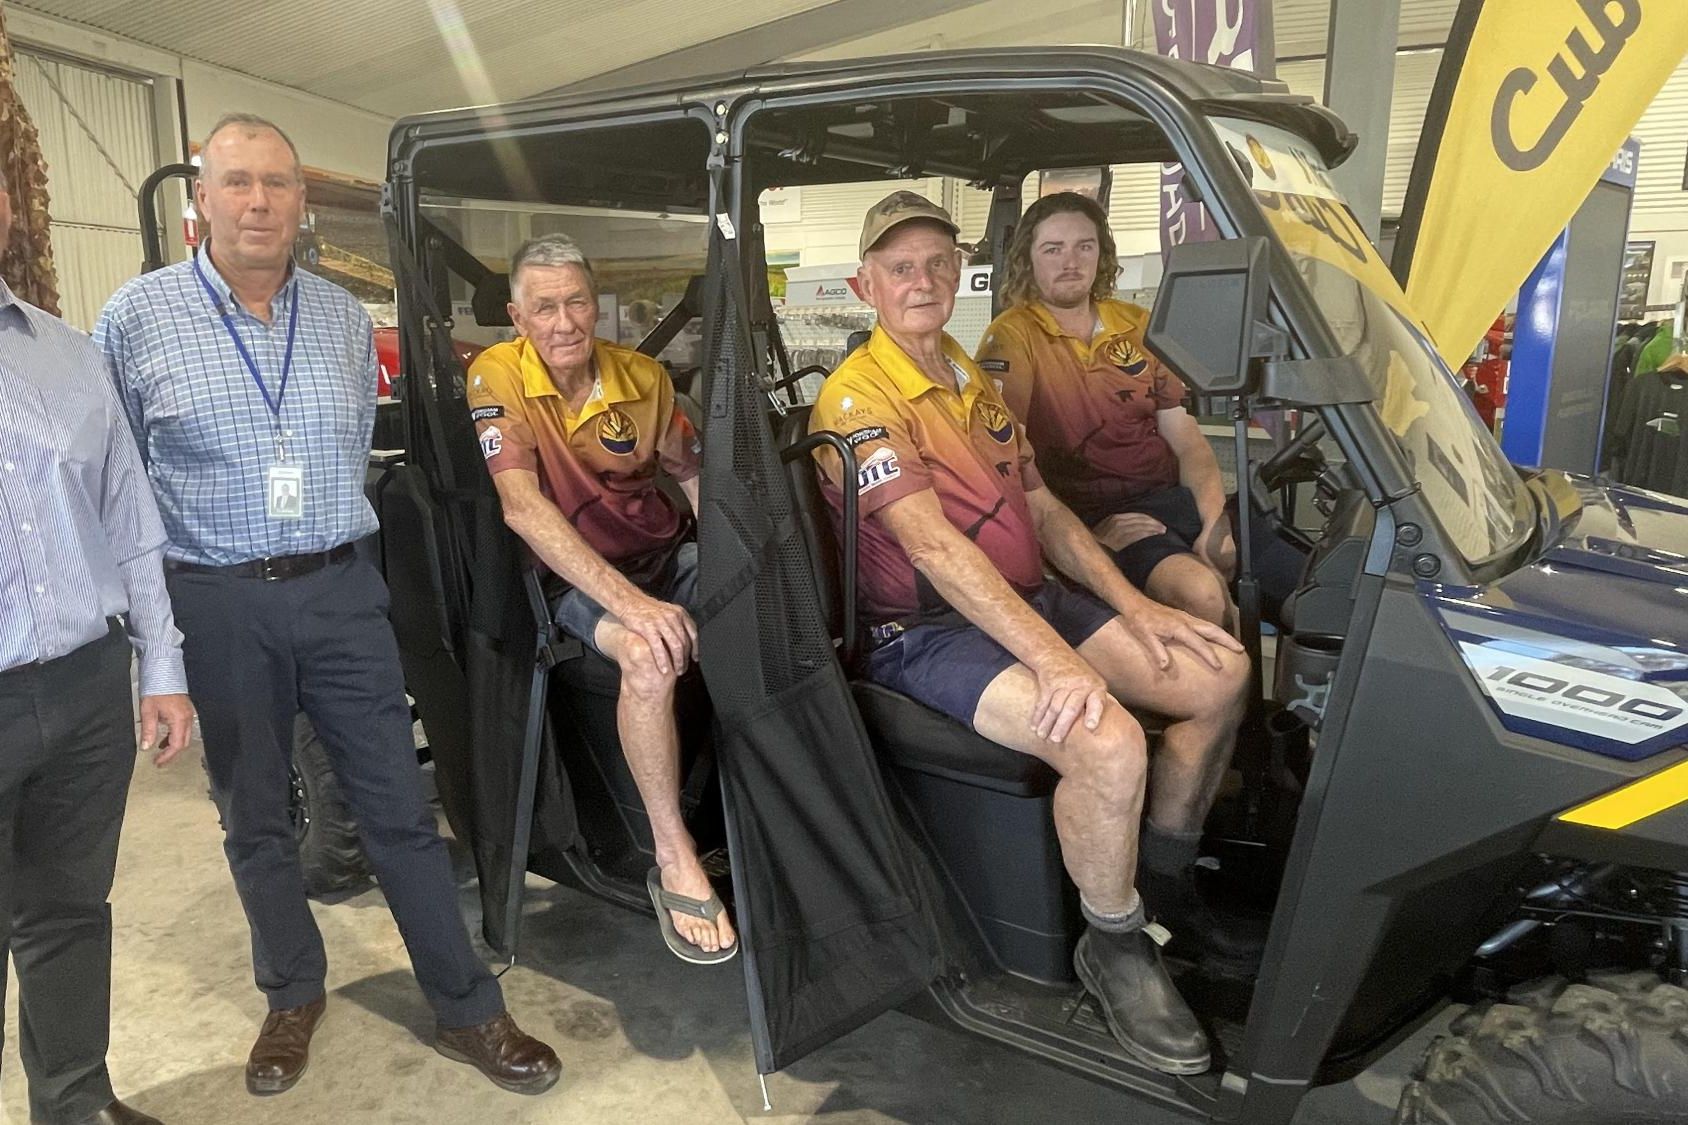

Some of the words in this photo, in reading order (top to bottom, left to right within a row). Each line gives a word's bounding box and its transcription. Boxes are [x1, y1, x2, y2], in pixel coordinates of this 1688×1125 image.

[825, 288, 847, 296] AGCO
[1487, 666, 1684, 721] 1000
[1496, 687, 1547, 701] SINGLE
[1551, 700, 1628, 723] OVERHEAD
[1629, 719, 1664, 730] CAM
